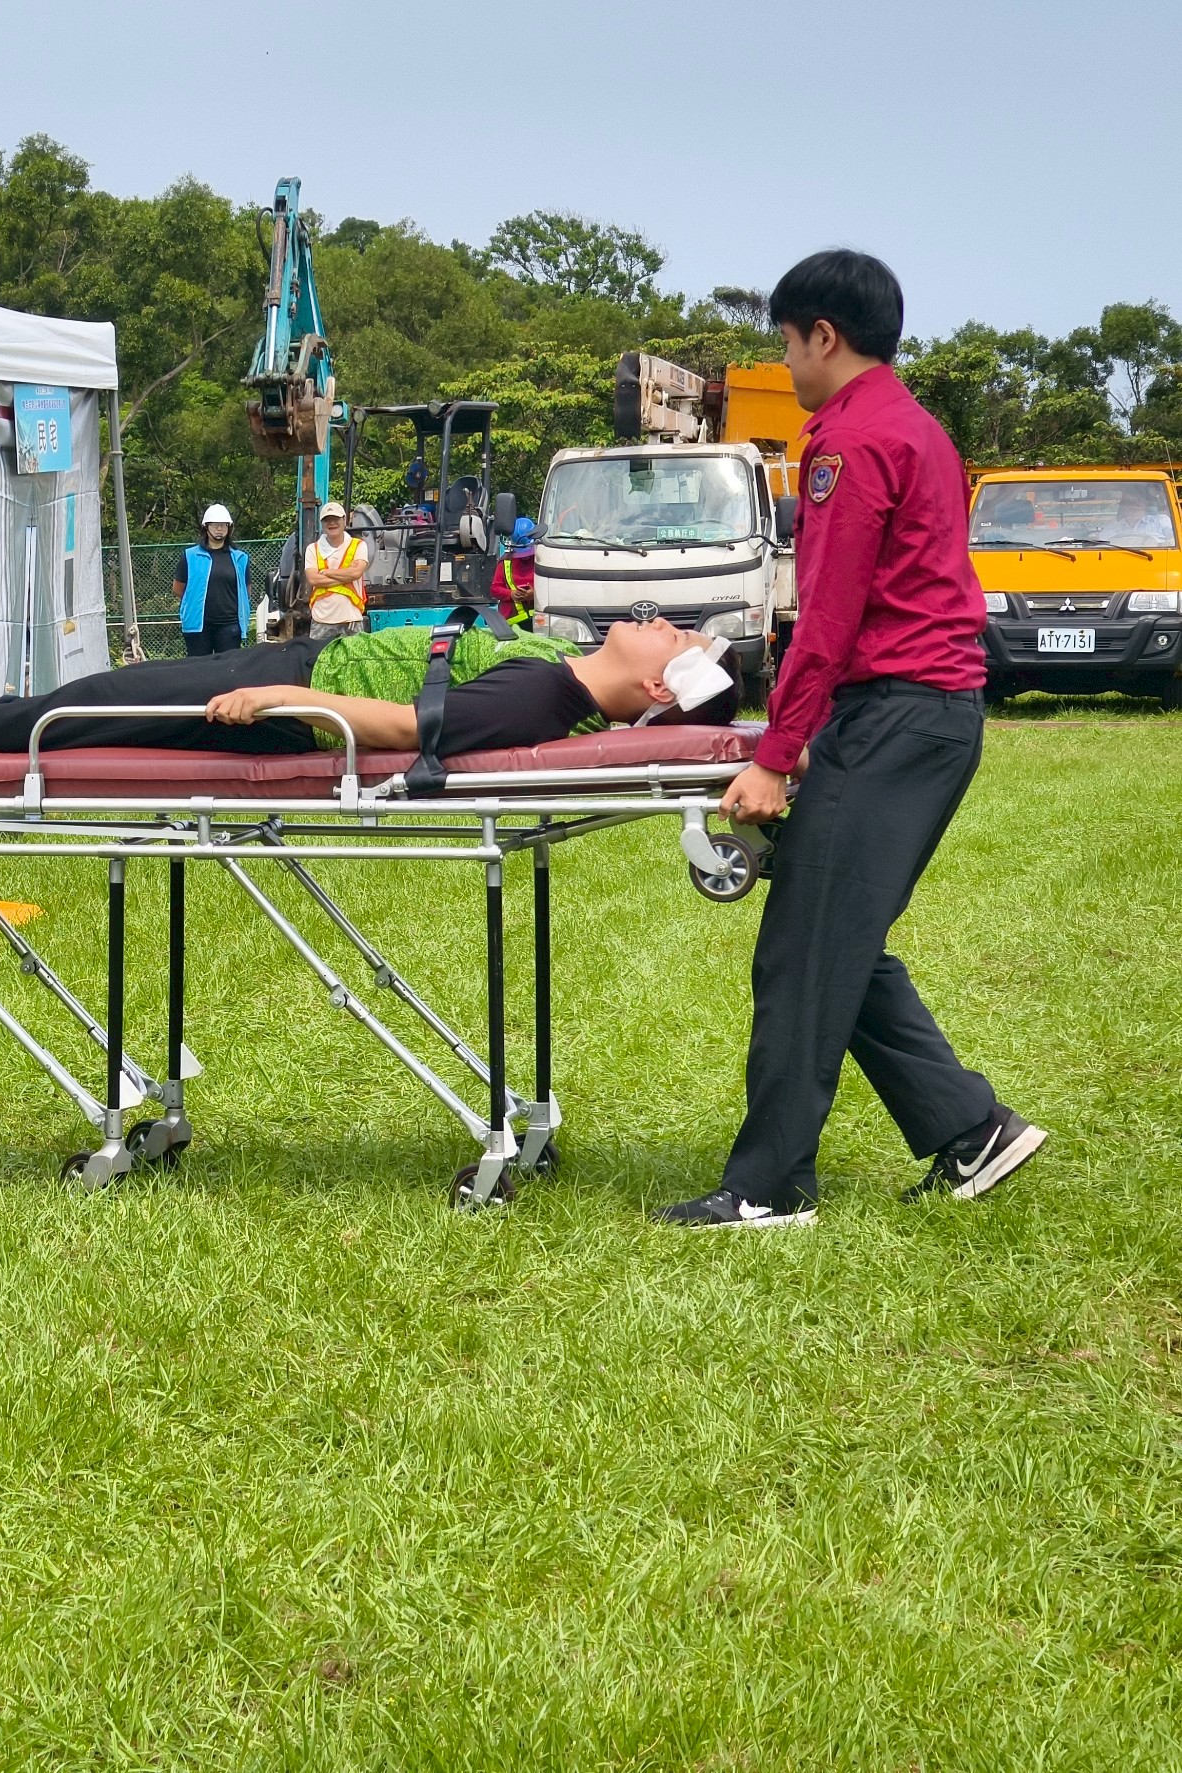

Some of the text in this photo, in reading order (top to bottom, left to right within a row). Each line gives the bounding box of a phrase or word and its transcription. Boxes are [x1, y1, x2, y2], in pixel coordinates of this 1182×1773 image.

[37, 420, 57, 451] 民宅
[660, 529, 695, 538] 公務執行中
